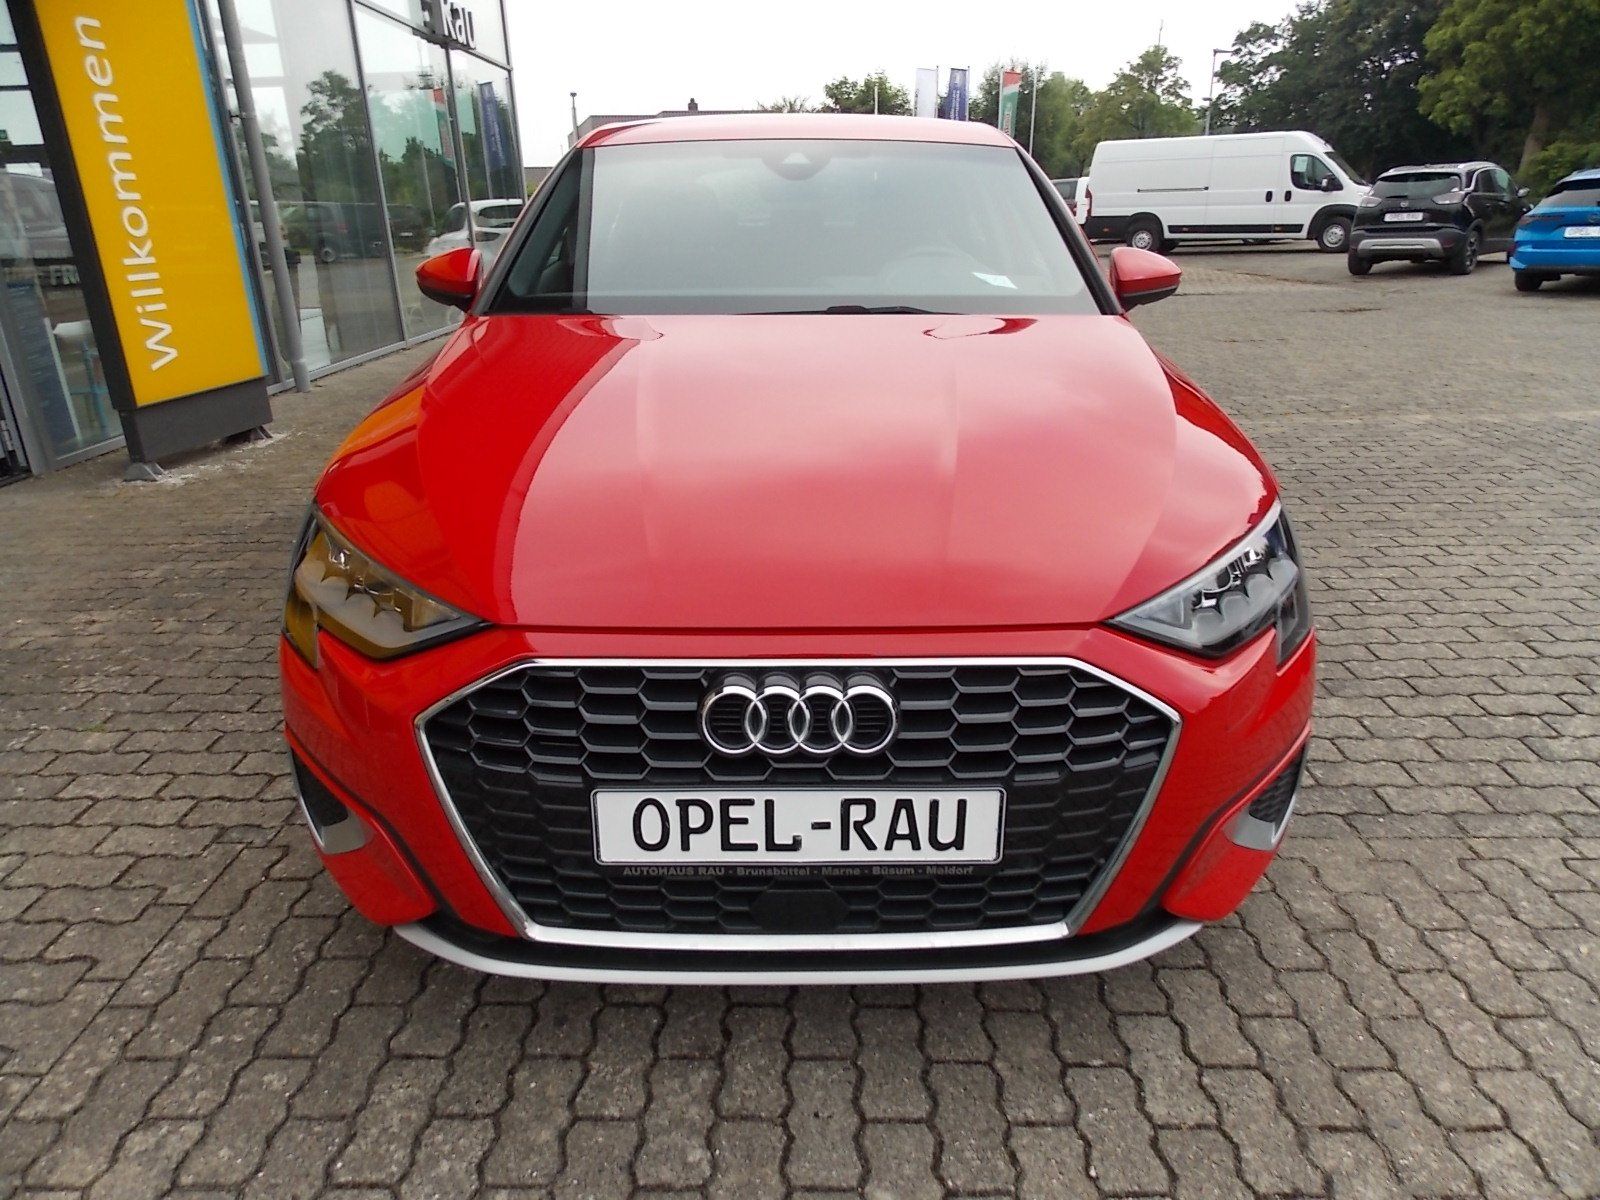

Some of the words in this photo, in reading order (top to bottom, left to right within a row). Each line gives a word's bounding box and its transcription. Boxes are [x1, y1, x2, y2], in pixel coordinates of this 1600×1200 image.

[74, 15, 179, 371] Willkommen
[632, 797, 967, 852] OPEL-RAU
[622, 866, 694, 876] AUTOHAUS
[698, 866, 725, 876] RAU
[736, 866, 811, 876] Brunsbüttel
[821, 866, 861, 876] Marne
[872, 865, 915, 875] Büsum
